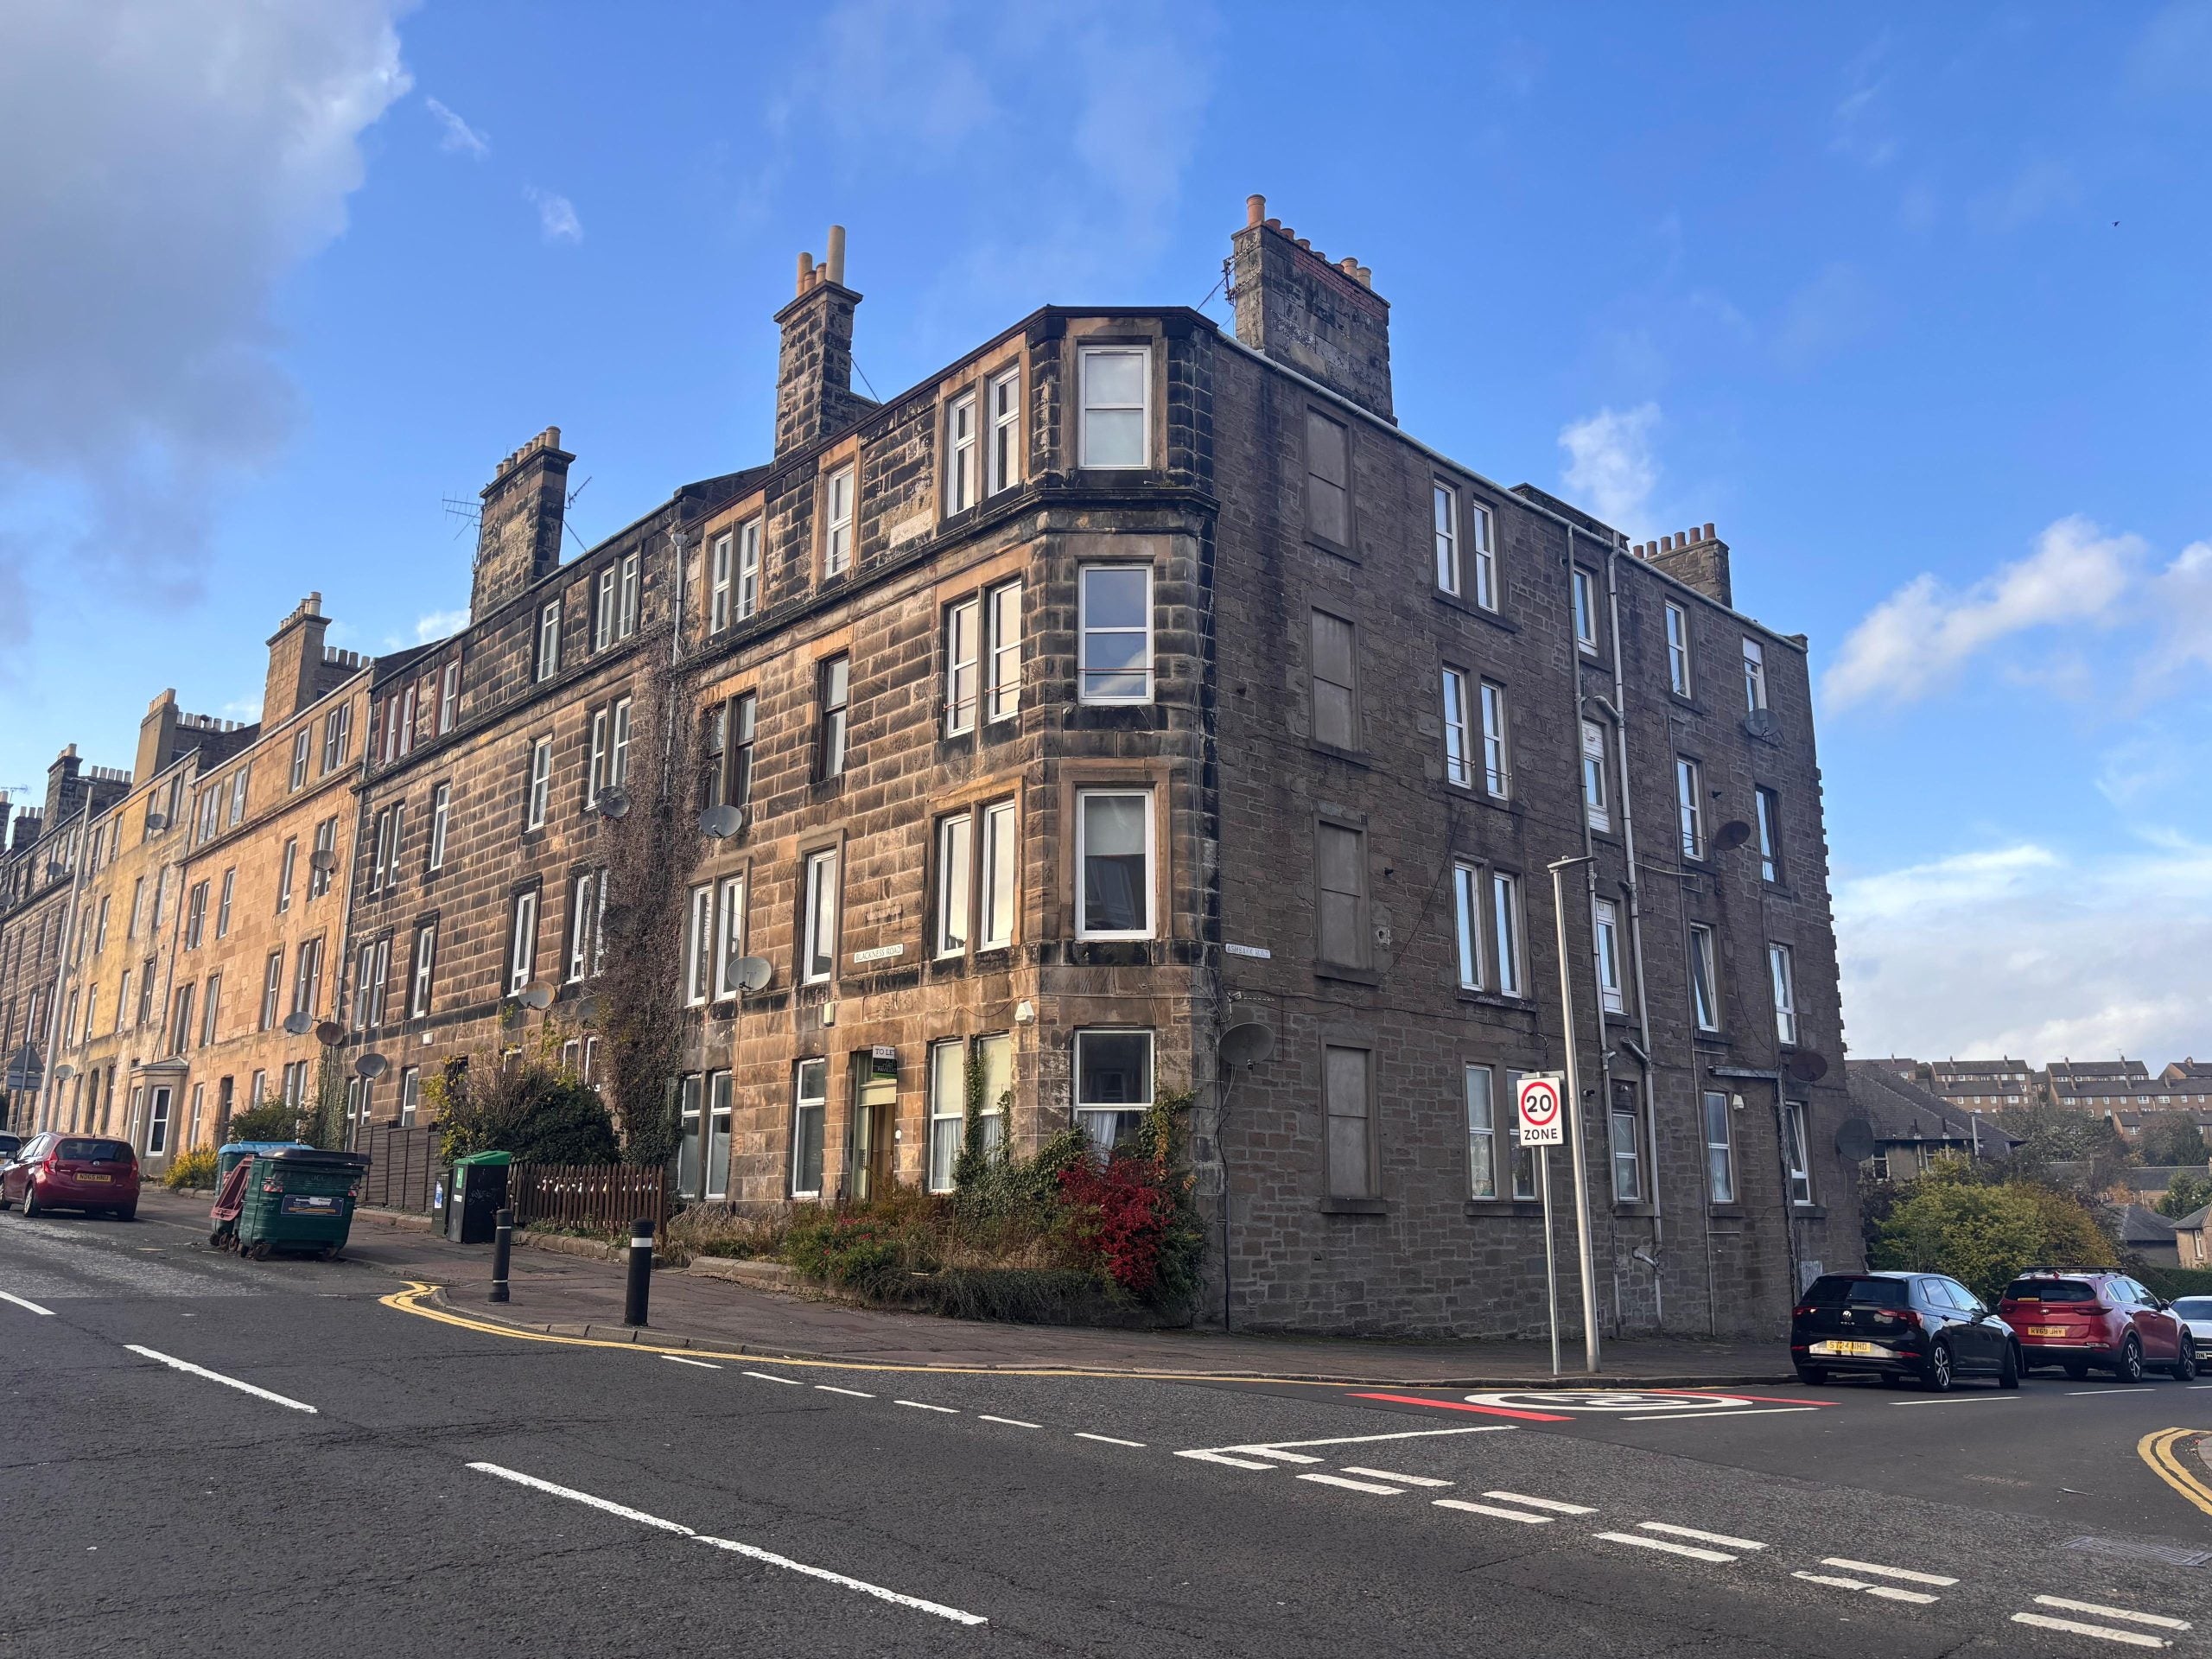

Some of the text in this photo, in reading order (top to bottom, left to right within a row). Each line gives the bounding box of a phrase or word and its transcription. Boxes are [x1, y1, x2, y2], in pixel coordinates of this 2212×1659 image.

[855, 946, 901, 961] BLACKNESS ROAD
[1255, 949, 1269, 958] ROAD
[1526, 1094, 1552, 1113] 20
[1523, 1128, 1558, 1141] ZONE
